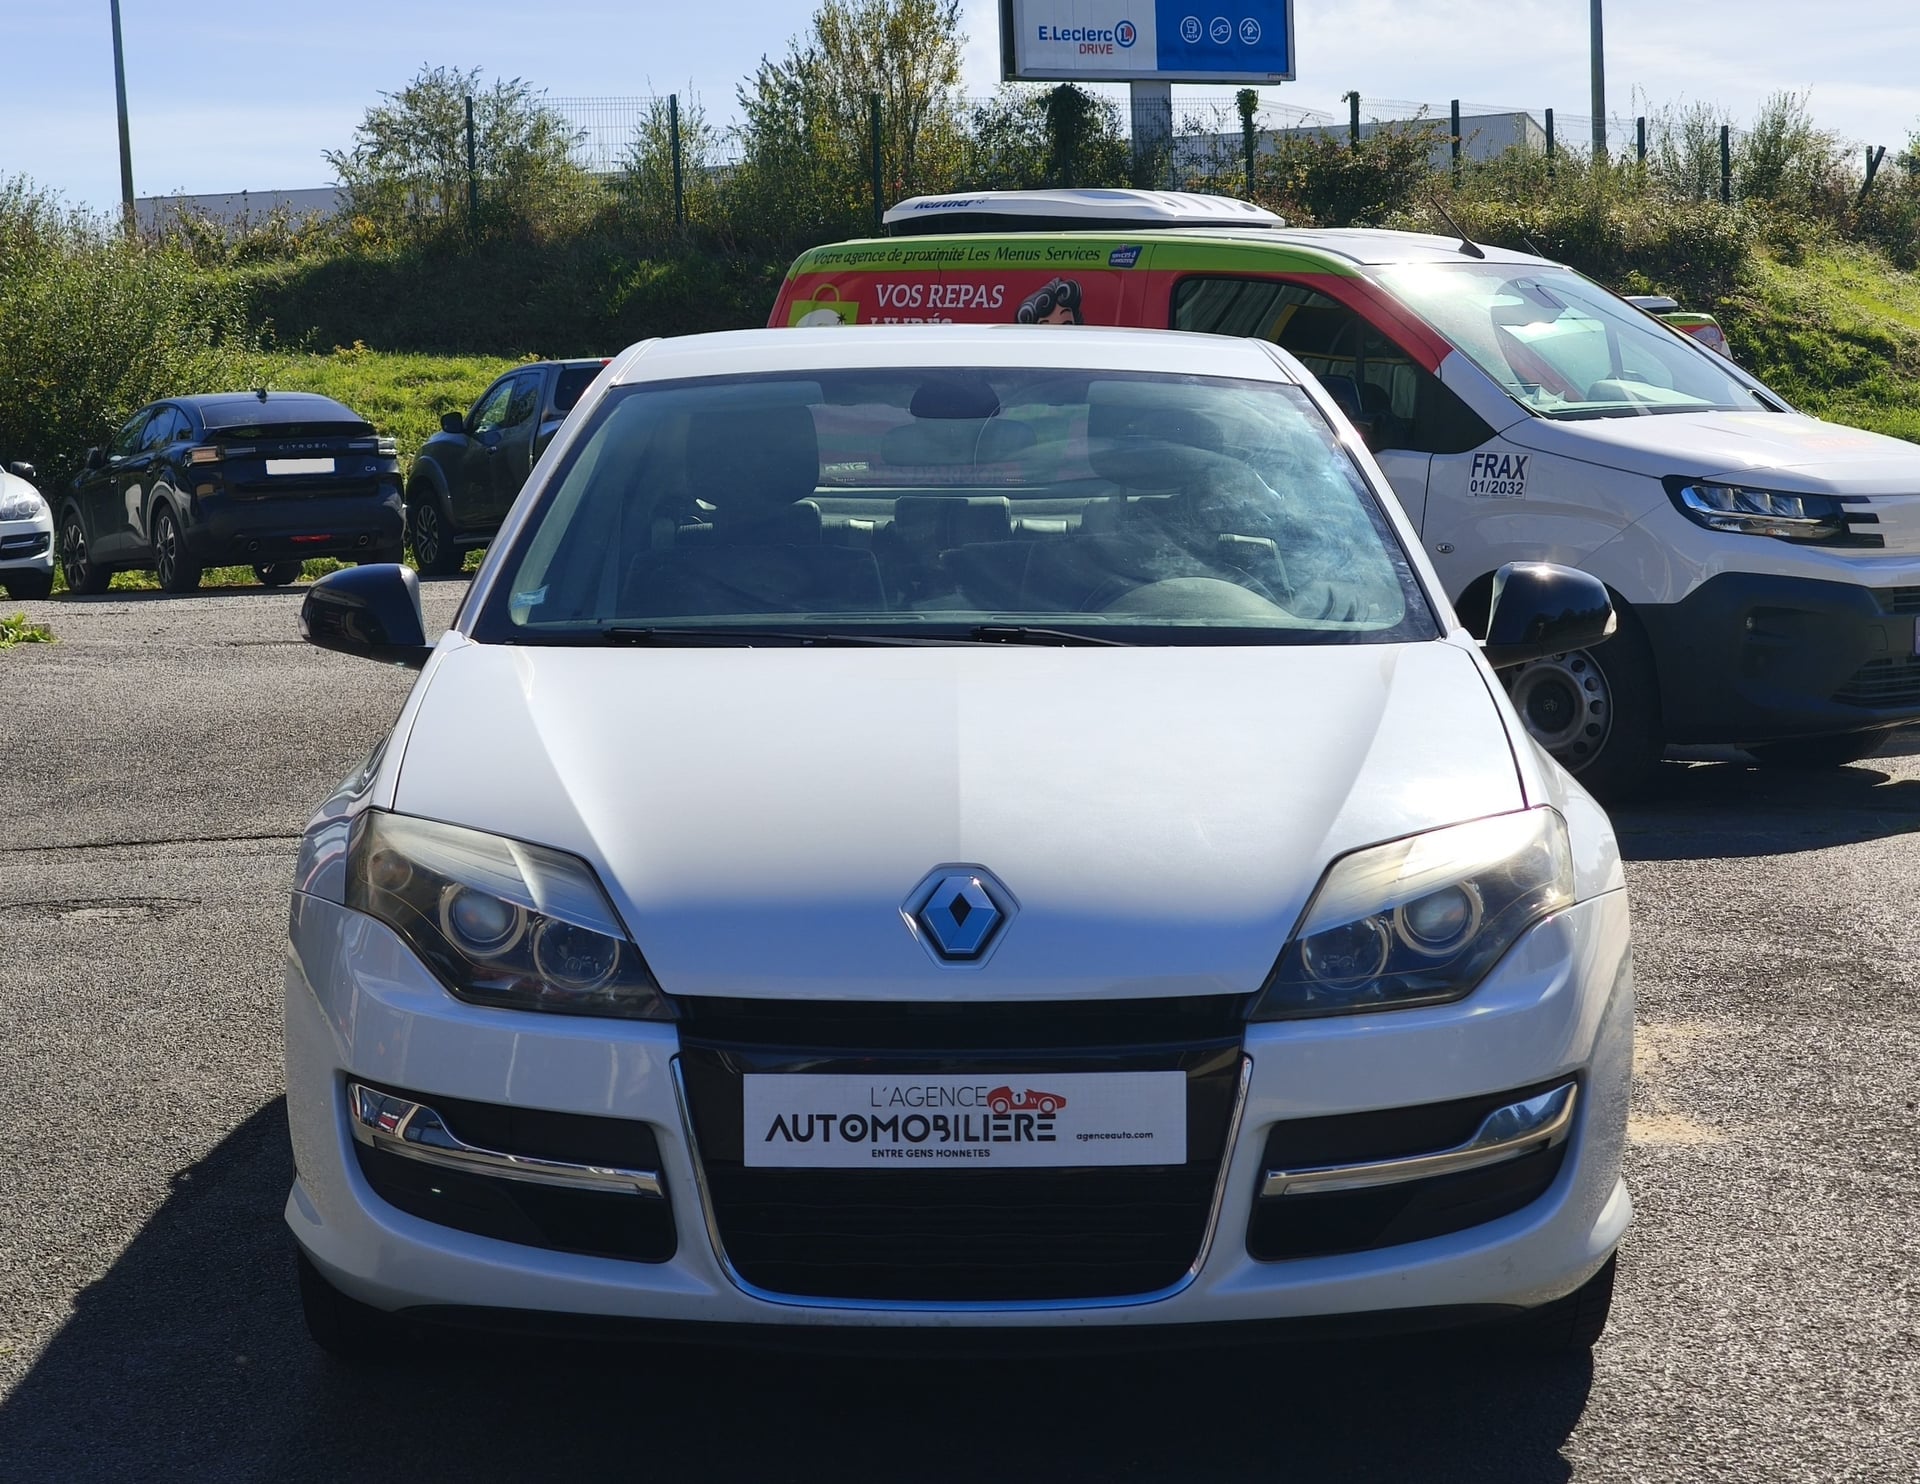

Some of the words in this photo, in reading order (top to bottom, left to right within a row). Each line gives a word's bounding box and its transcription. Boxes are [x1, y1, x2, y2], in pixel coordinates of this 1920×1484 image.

[1038, 26, 1113, 42] E.Leclerc
[1079, 43, 1113, 55] DRIVE
[814, 253, 841, 265] Votre
[843, 250, 884, 265] agence
[887, 248, 902, 262] de
[904, 246, 965, 264] proximité
[968, 247, 990, 261] Les
[993, 247, 1041, 261] Menus
[1045, 246, 1101, 261] Services
[875, 284, 923, 308] VOS
[926, 284, 1005, 308] REPAS
[1471, 453, 1528, 480] FRAX
[1470, 480, 1524, 495] 01/2032
[870, 1086, 988, 1108] L'AGENCE
[764, 1113, 1057, 1143] AUTOMOBILIERE
[1076, 1131, 1154, 1142] agenceauto.com
[871, 1149, 904, 1158] ENTRE
[905, 1149, 934, 1158] GENS
[936, 1149, 991, 1158] HONNETES
